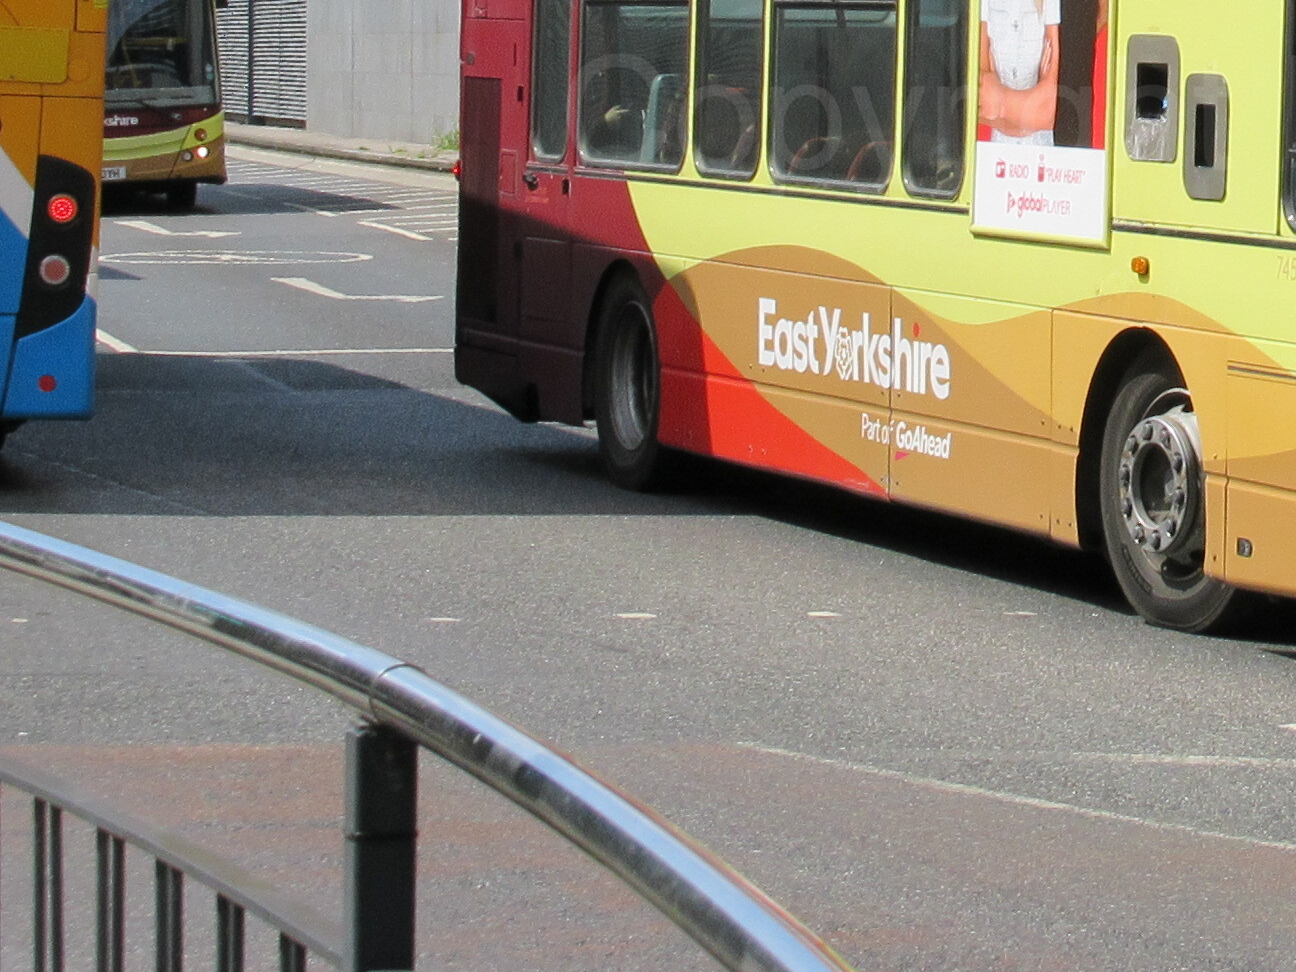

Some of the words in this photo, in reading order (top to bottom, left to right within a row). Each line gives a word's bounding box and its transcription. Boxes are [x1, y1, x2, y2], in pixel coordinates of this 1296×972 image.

[758, 297, 820, 375] East
[819, 305, 951, 400] Yorkshire
[861, 412, 882, 444] Part
[896, 420, 952, 459] GoAhead
